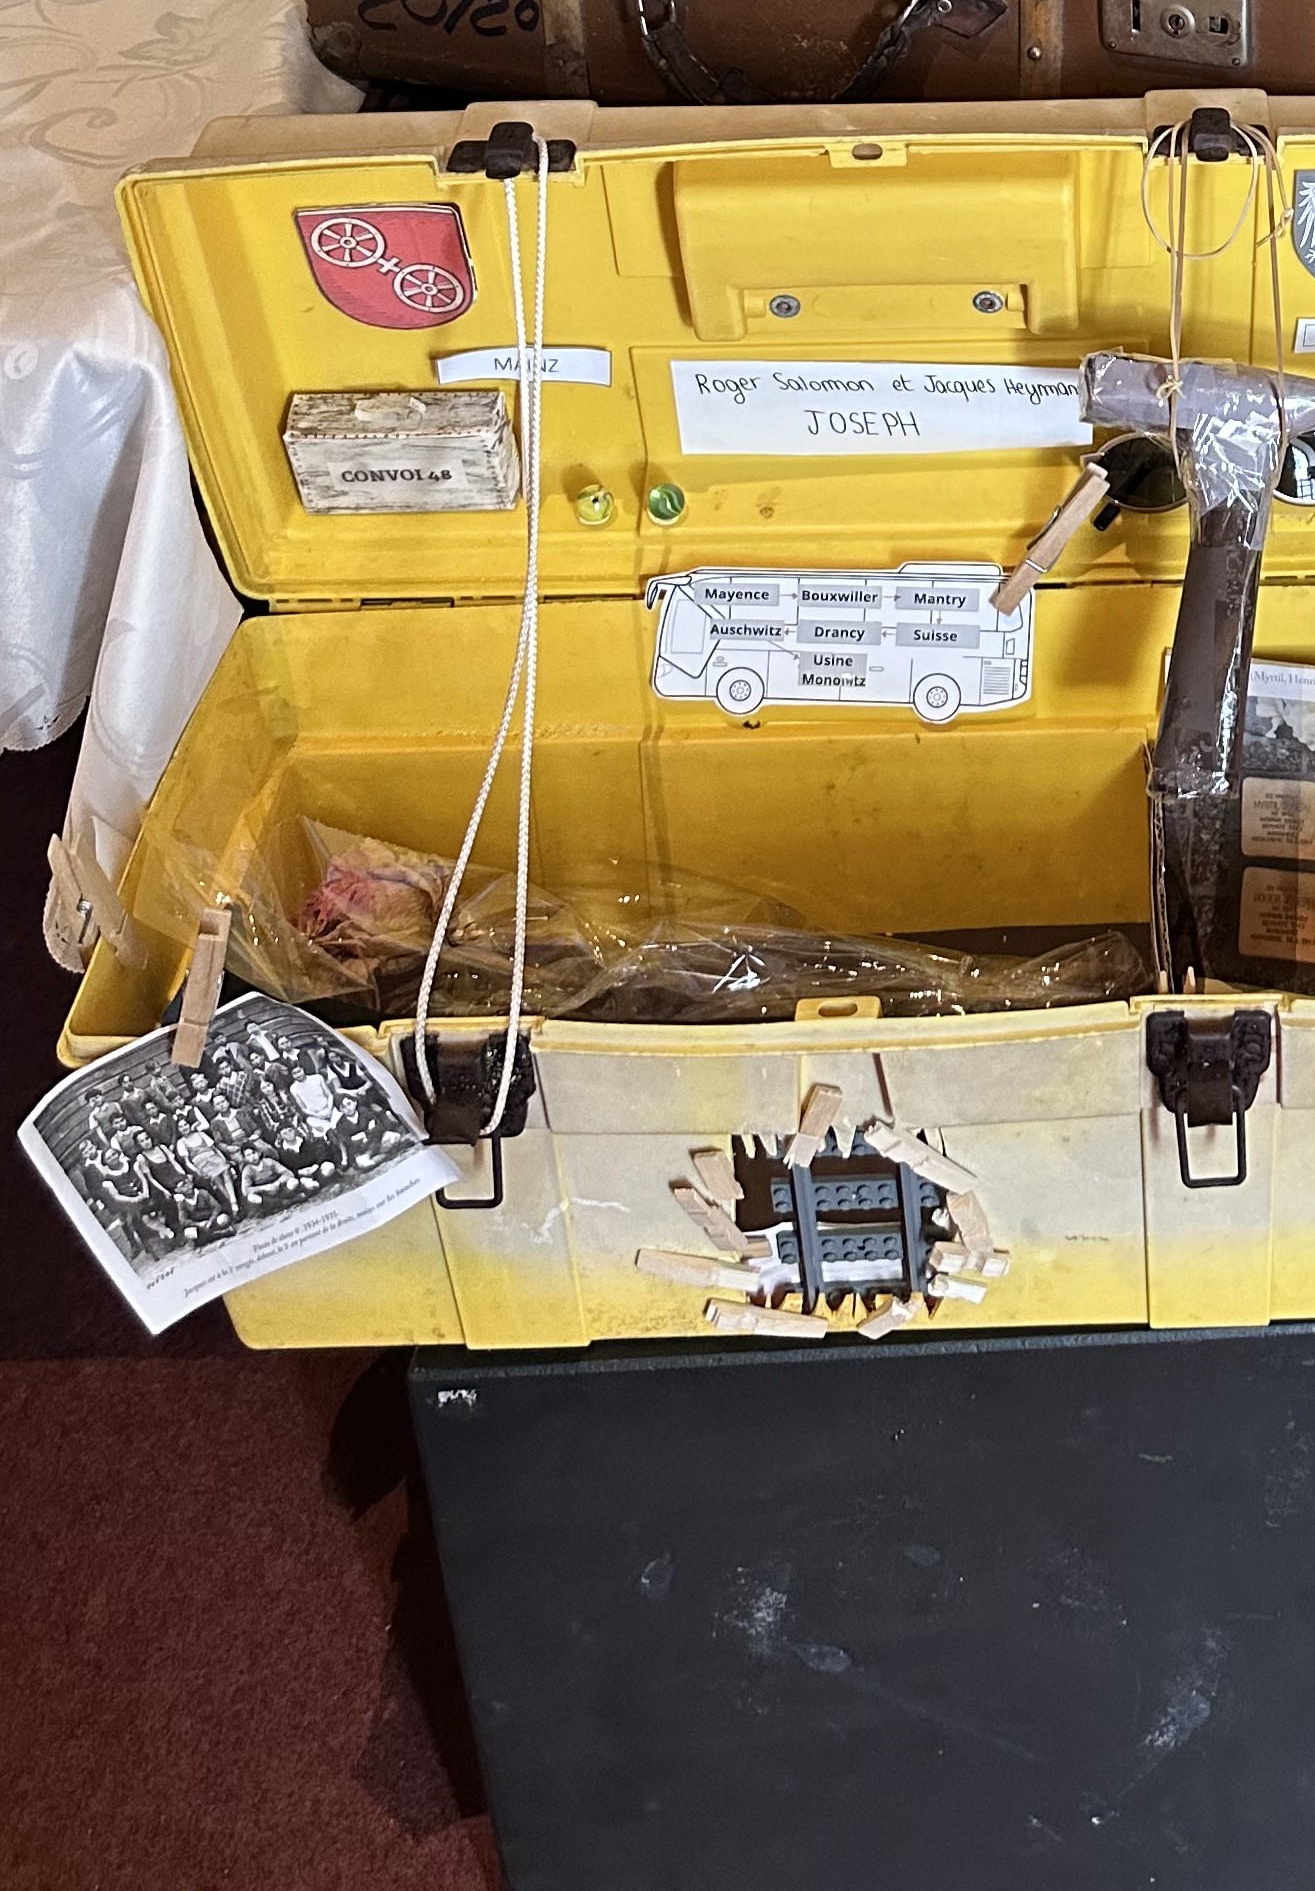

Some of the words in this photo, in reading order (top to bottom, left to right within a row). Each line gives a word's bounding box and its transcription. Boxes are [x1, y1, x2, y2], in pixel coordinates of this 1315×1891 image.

[696, 372, 761, 405] Roger
[772, 372, 875, 393] Salomon
[892, 379, 913, 393] et
[923, 374, 997, 403] Jacques
[1006, 376, 1079, 405] Heyman
[804, 409, 922, 437] JOSEPH
[341, 469, 423, 483] CONVOI
[428, 469, 453, 483] 48
[704, 587, 770, 603] Mayence
[801, 589, 879, 604] Bouxwiller
[913, 593, 967, 609] Mantry
[709, 623, 782, 638] Auschwitz
[814, 626, 865, 642] Drancy
[913, 628, 958, 643] Suisse
[812, 653, 854, 668] Usine
